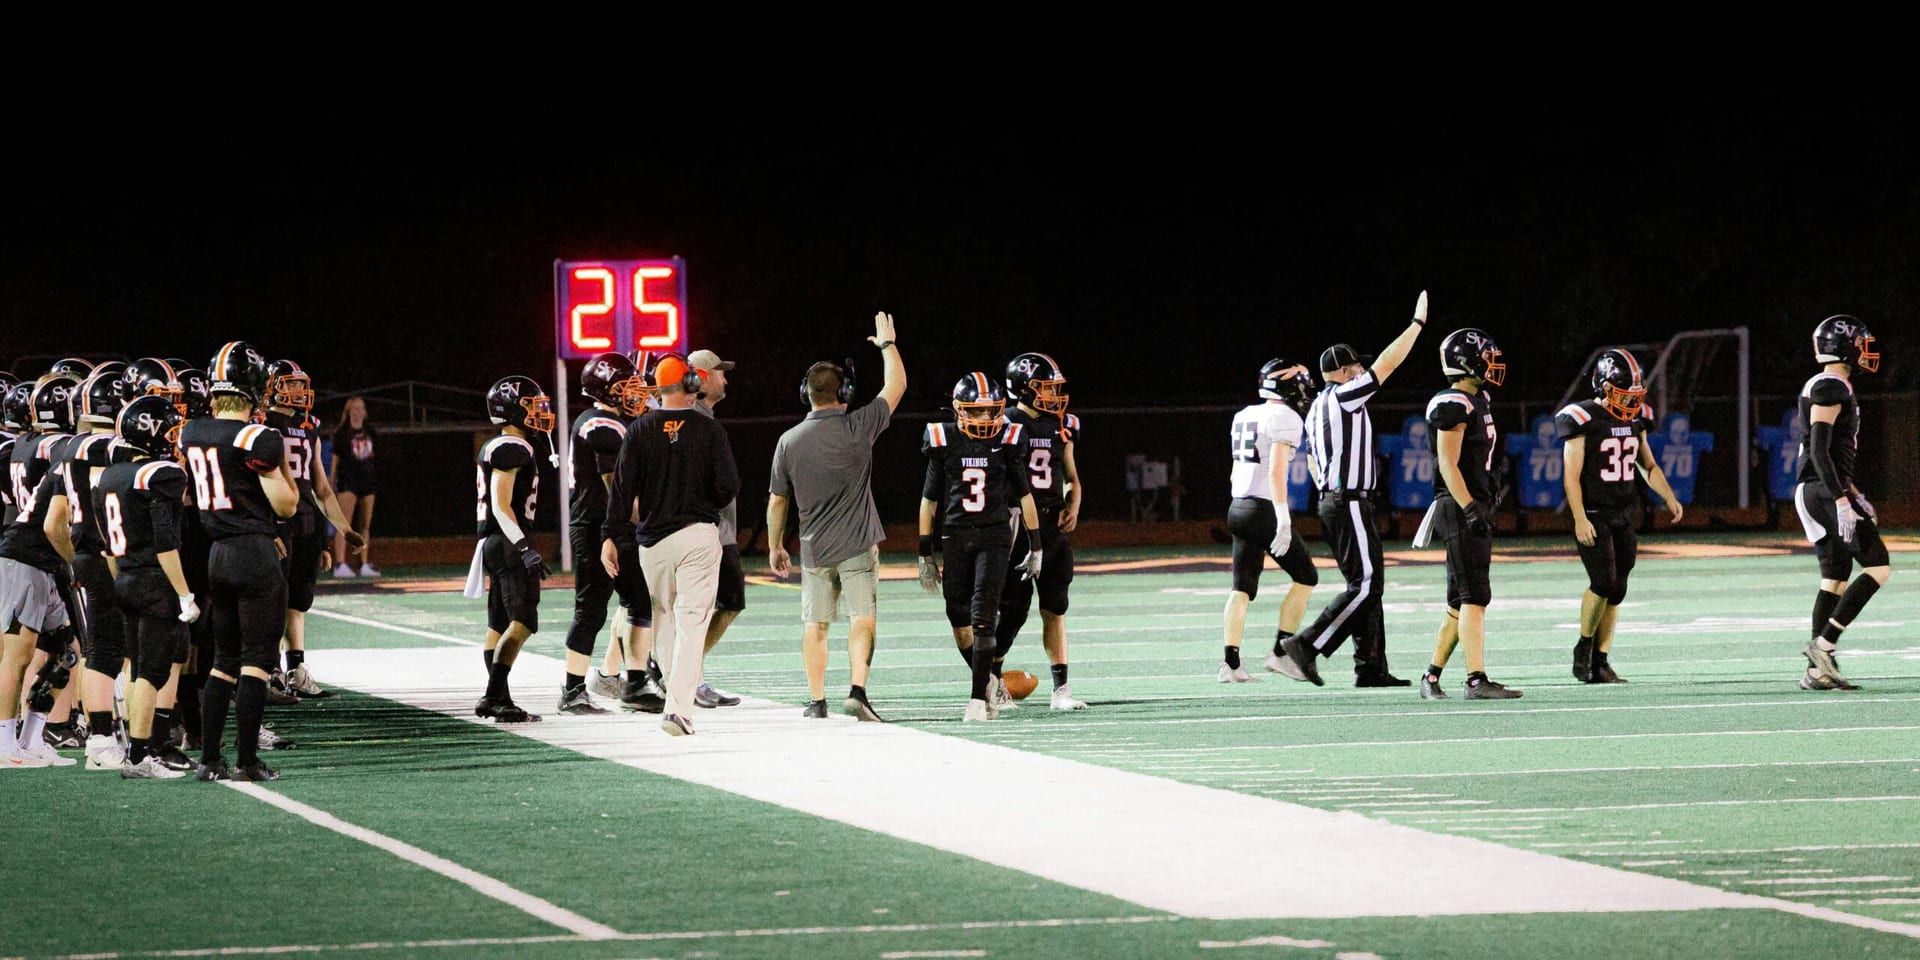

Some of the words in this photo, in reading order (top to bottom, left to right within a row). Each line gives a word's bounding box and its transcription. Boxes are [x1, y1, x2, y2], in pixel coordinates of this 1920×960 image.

[571, 267, 678, 348] 25
[1834, 320, 1857, 337] SV
[1466, 332, 1487, 350] SV
[594, 361, 617, 382] SV
[1017, 358, 1040, 378] SV
[190, 377, 210, 398] SV
[500, 381, 521, 398] SV
[137, 412, 163, 437] SV
[663, 420, 685, 433] SV
[1610, 426, 1632, 437] VIKINGS
[1029, 438, 1052, 448] VIKINGS
[961, 457, 989, 468] VIKINGS
[1029, 449, 1052, 489] 9
[1529, 456, 1562, 481] 70
[1600, 436, 1639, 482] 32
[1661, 454, 1693, 478] 70
[187, 446, 233, 511] 81
[961, 468, 987, 513] 3
[104, 492, 127, 557] 8
